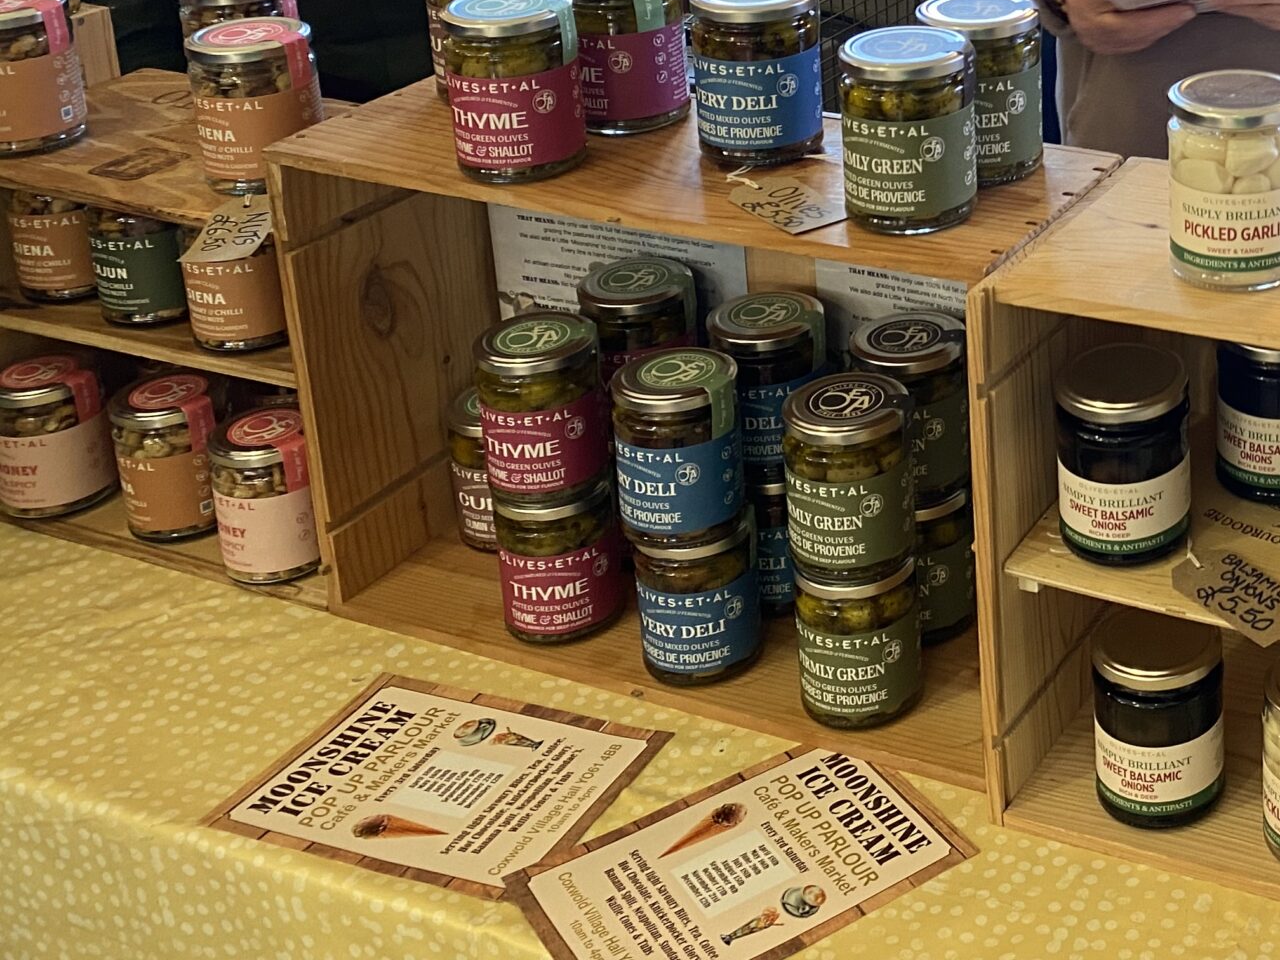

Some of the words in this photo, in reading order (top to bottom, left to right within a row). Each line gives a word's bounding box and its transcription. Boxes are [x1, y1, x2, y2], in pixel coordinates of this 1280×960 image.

[694, 57, 784, 76] LIVES·ET·AL
[447, 75, 540, 94] LIVES·ET·AL
[696, 86, 727, 109] VERY
[732, 95, 778, 110] DELI
[451, 106, 528, 130] THYME
[716, 115, 739, 124] MIXED
[742, 116, 771, 124] OLIVES
[471, 133, 496, 142] GREEN
[498, 133, 528, 142] OLIVES
[717, 125, 729, 137] DE
[731, 125, 783, 138] PROVENCE
[476, 146, 487, 156] &
[489, 143, 534, 157] SHALLOT
[872, 158, 923, 175] GREEN
[857, 176, 880, 188] GREEN
[882, 181, 913, 189] OLIVES
[768, 187, 832, 219] Olives
[859, 186, 869, 199] DE
[871, 190, 926, 203] PROVENCE
[1182, 201, 1220, 221] SIMPLY
[231, 211, 269, 246] NUTS
[1184, 219, 1237, 241] PICKLED
[1207, 246, 1232, 255] SWEET
[1240, 246, 1264, 254] TANGY
[1183, 252, 1238, 270] INGREDIENTS
[186, 288, 226, 305] SIENA
[1063, 483, 1097, 506] SIMPLY
[1099, 491, 1164, 508] BRILLIANT
[1069, 501, 1098, 519] SWEET
[1100, 506, 1154, 521] BALSAMIC
[1091, 519, 1127, 531] ONIONS
[1219, 570, 1279, 612] ONIONS
[1196, 585, 1276, 633] £5.50
[247, 701, 397, 815] MOONSHINE
[278, 781, 333, 817] ICE
[328, 709, 418, 776] CREAM
[299, 796, 338, 828] POP
[337, 773, 365, 794] UP
[364, 706, 446, 773] PARLOUR
[320, 804, 356, 830] Café
[353, 791, 369, 803] &
[368, 751, 418, 791] Makers
[412, 711, 461, 750] Market
[488, 836, 533, 876] Coxwold
[530, 803, 563, 834] Village
[562, 782, 579, 804] Hall
[579, 762, 604, 784] YO61
[601, 743, 622, 762] 4BB
[547, 811, 572, 833] 10am
[570, 802, 580, 812] to
[578, 785, 597, 803] 4pm
[760, 821, 778, 839] Every
[776, 836, 788, 849] 3rd
[786, 848, 809, 874] Saturday
[618, 860, 629, 874] Hot
[604, 867, 626, 894] Banana
[619, 915, 639, 935] Cones
[633, 932, 643, 940] &
[637, 938, 655, 956] Tubs
